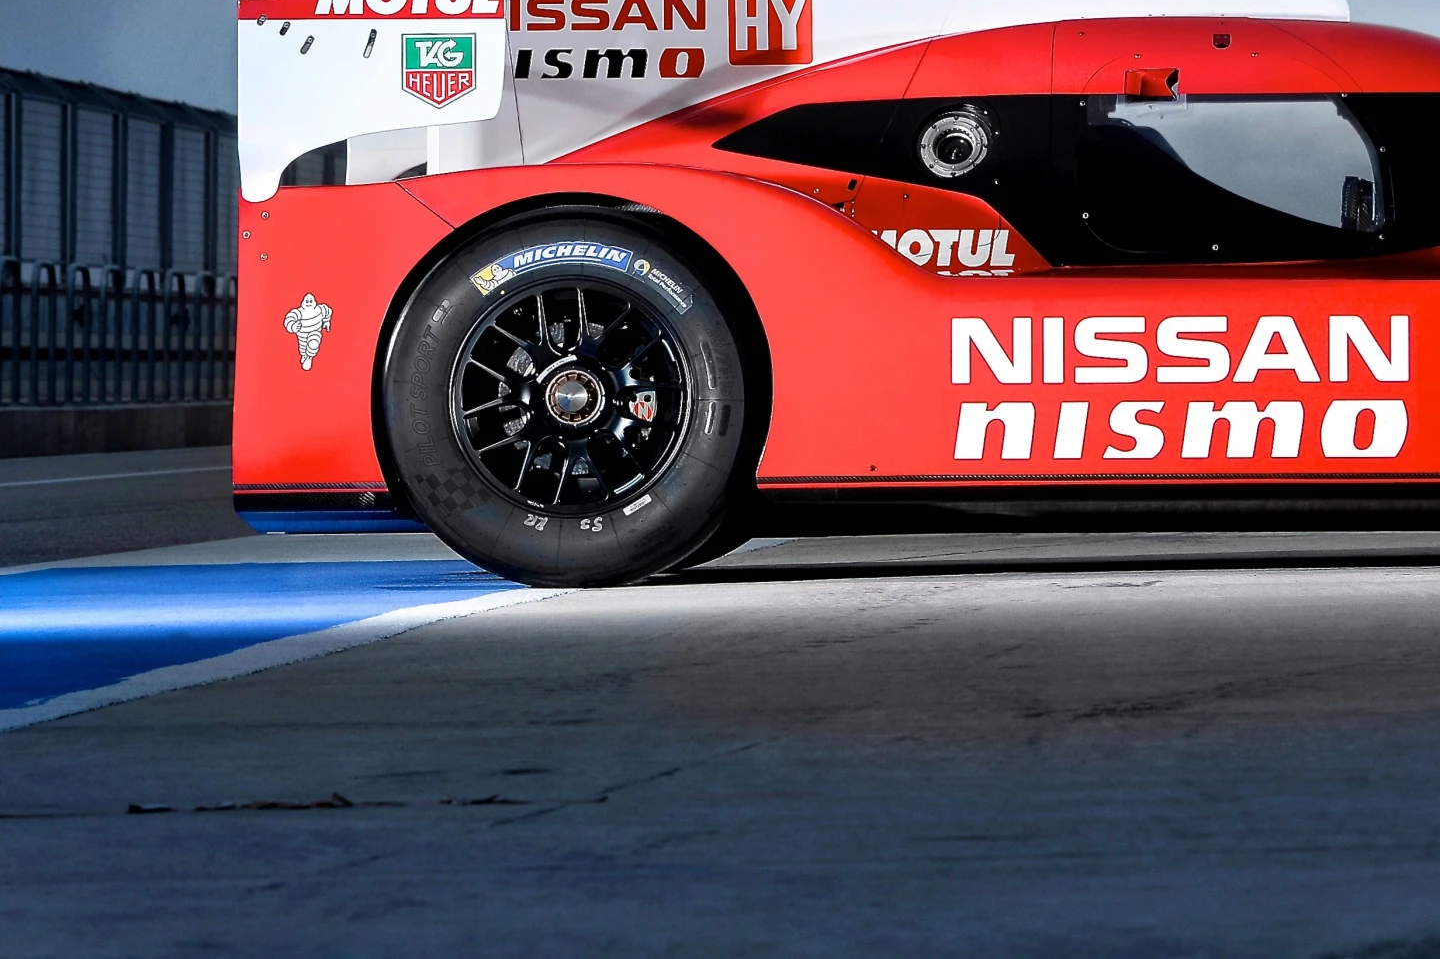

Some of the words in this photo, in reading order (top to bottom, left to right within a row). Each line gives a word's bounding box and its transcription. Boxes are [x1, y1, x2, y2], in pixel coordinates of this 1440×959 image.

[414, 38, 465, 68] TAG
[513, 48, 706, 79] ismo
[409, 73, 471, 101] HEUER
[513, 243, 628, 269] MICHELIN
[651, 268, 684, 295] MICHELIN
[410, 324, 440, 400] SPORT
[950, 315, 1411, 385] NISSAN
[411, 403, 442, 467] PILOT
